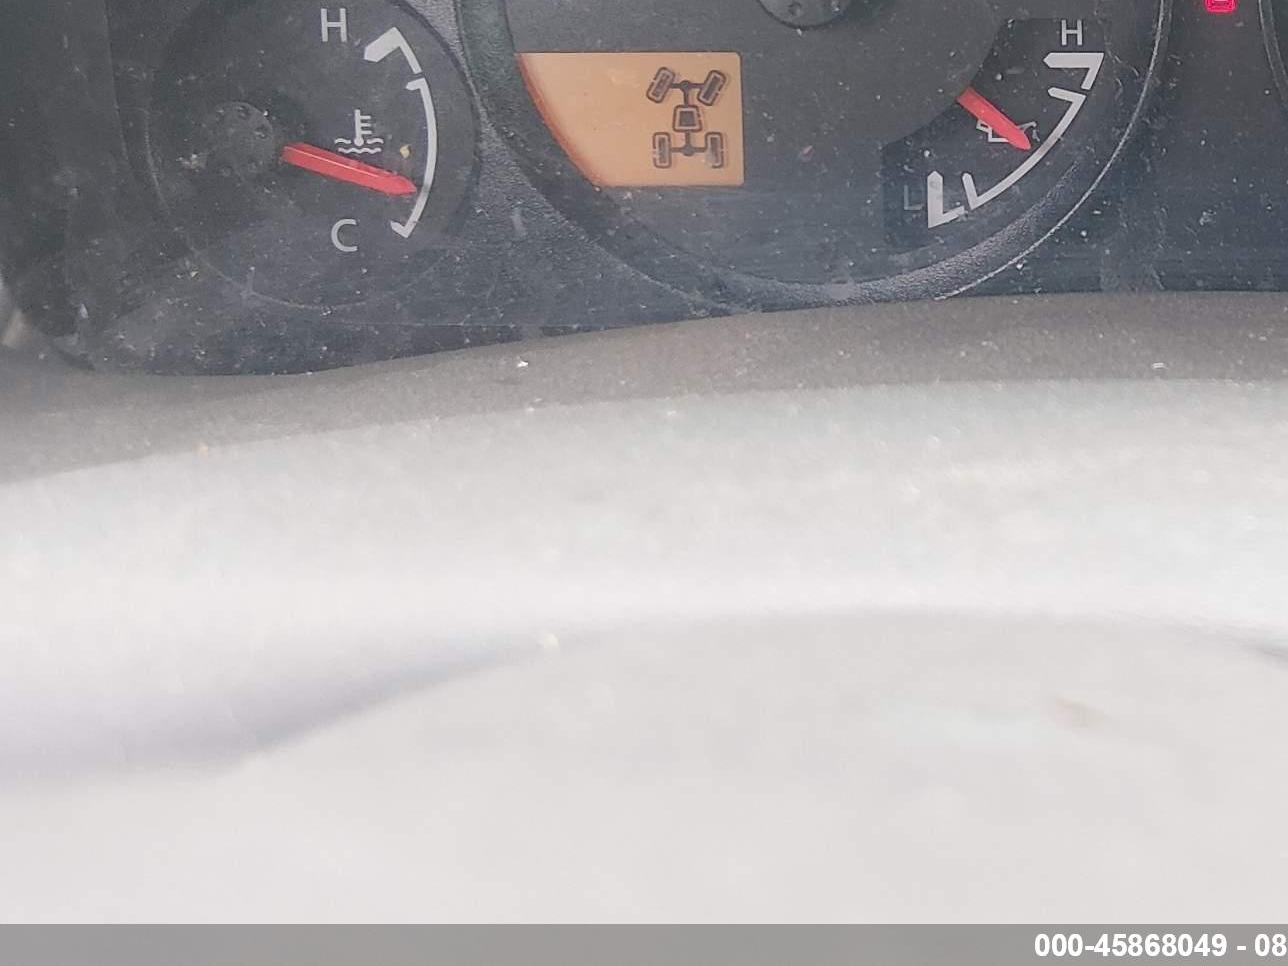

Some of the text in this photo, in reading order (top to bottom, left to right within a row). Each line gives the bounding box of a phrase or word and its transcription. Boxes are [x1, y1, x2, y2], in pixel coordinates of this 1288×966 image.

[320, 7, 347, 43] H
[1061, 19, 1083, 46] H
[903, 185, 922, 211] L
[330, 218, 358, 252] C
